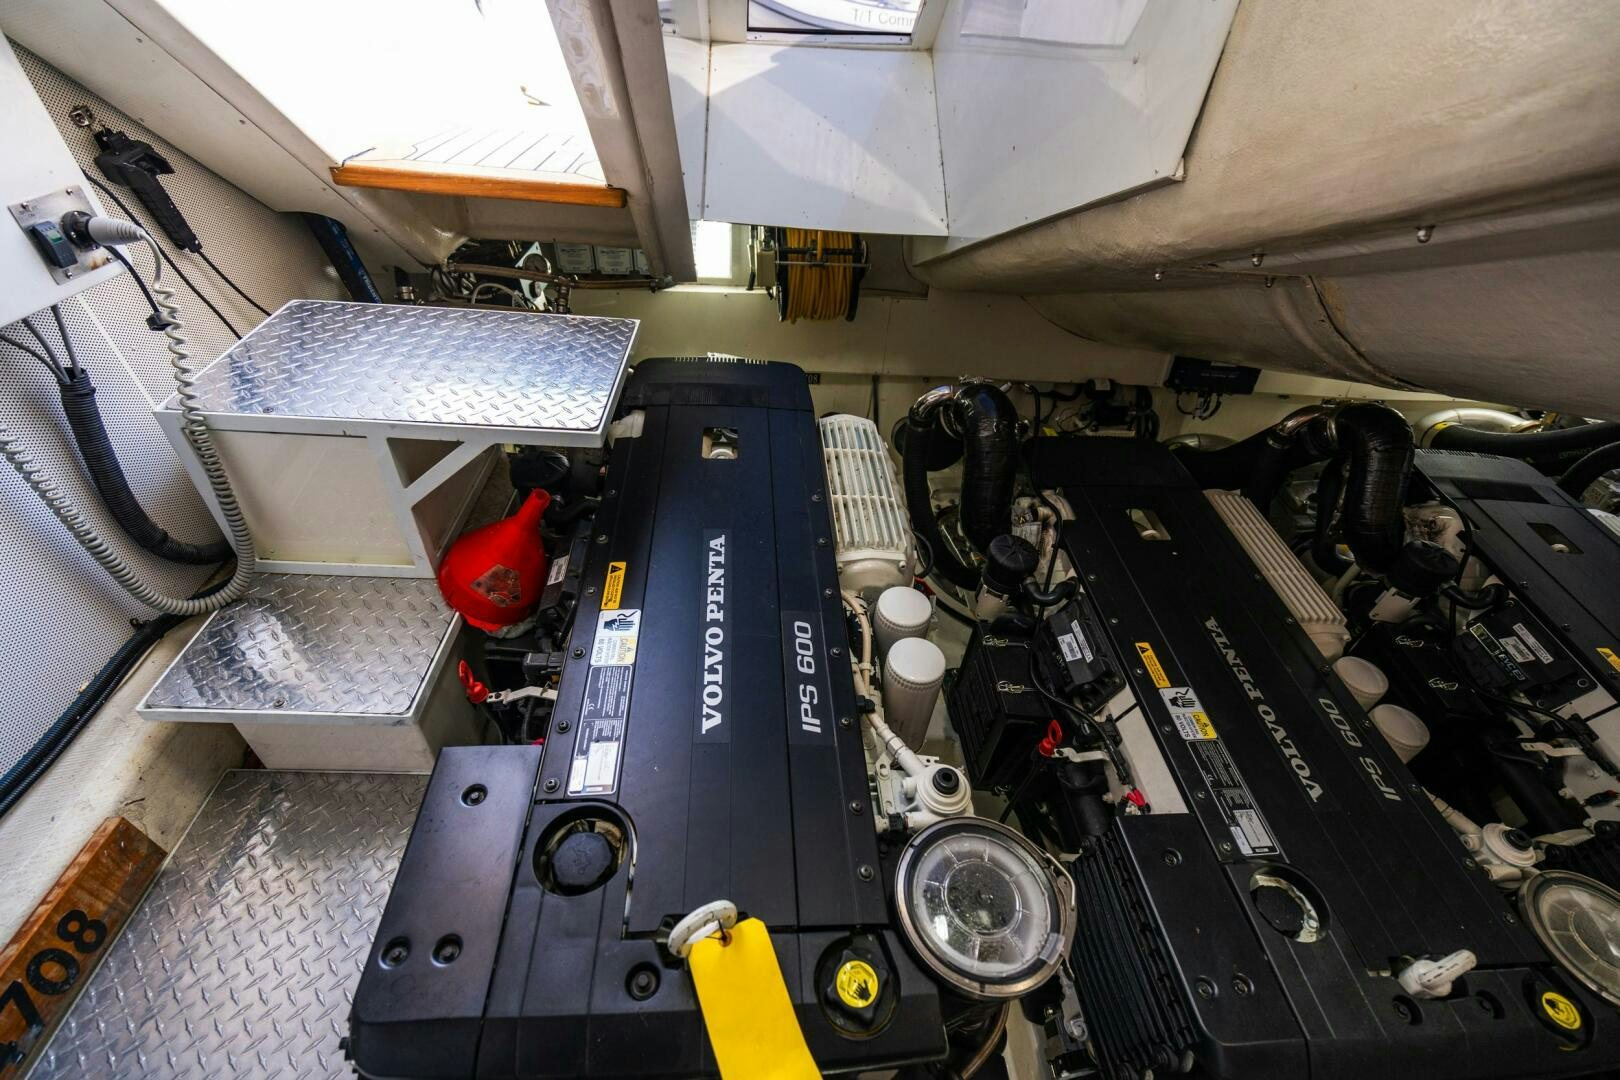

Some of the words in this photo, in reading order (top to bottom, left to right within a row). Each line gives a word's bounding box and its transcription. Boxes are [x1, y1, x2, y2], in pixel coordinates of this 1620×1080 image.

[706, 535, 726, 622] PENTA
[702, 627, 724, 734] VOLVO
[794, 620, 815, 675] 600
[1204, 616, 1265, 701] PENTA
[800, 683, 822, 733] IPS
[1318, 698, 1364, 748] 600
[1257, 704, 1324, 803] VOLVO
[1359, 756, 1402, 802] IPS
[0, 909, 108, 1070] 708
